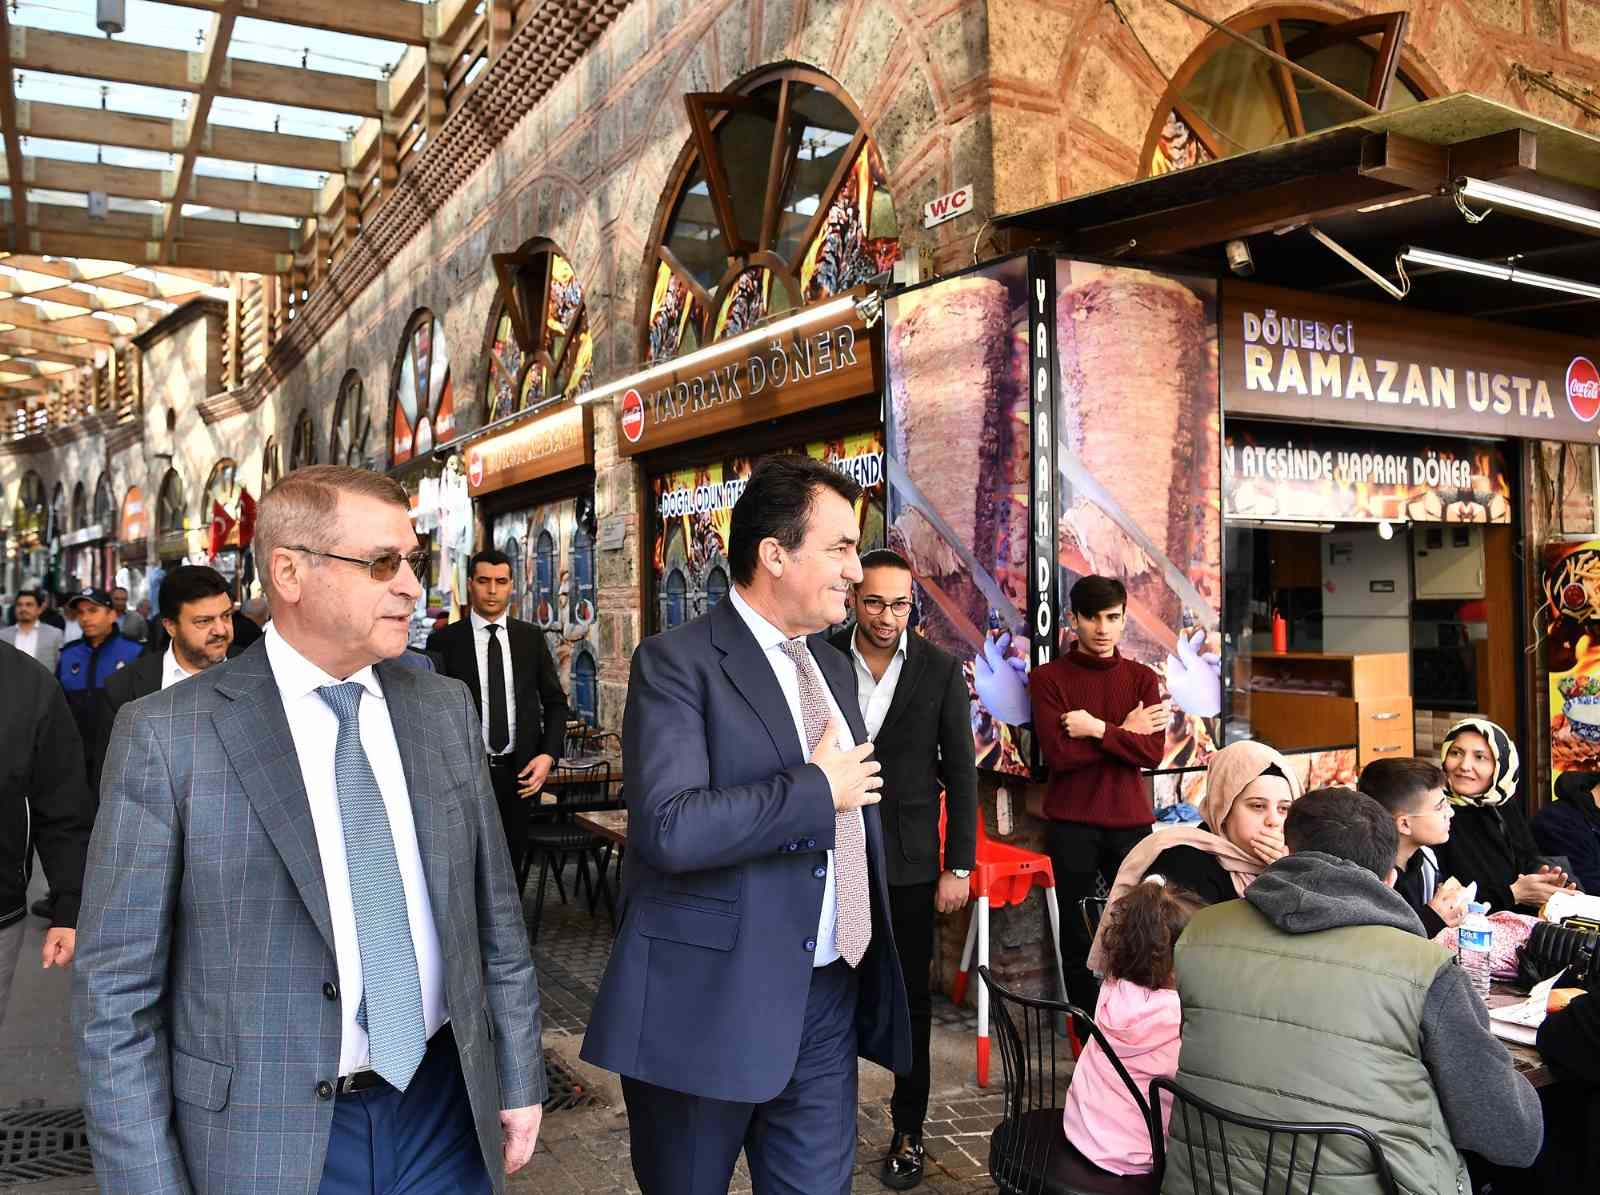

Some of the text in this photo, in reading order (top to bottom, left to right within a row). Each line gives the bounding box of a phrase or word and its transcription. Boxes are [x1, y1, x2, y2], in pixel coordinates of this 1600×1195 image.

[930, 190, 967, 217] WC
[1243, 309, 1354, 354] DÖNERCİ
[651, 325, 858, 425] YAPRAK DÖNER
[1244, 343, 1556, 419] RAMAZAN USTA
[1036, 278, 1051, 666] YAPRAK DÖN
[1337, 451, 1408, 485] YAPRAK
[1412, 451, 1472, 489] DÖNER
[695, 483, 724, 511] ODUN
